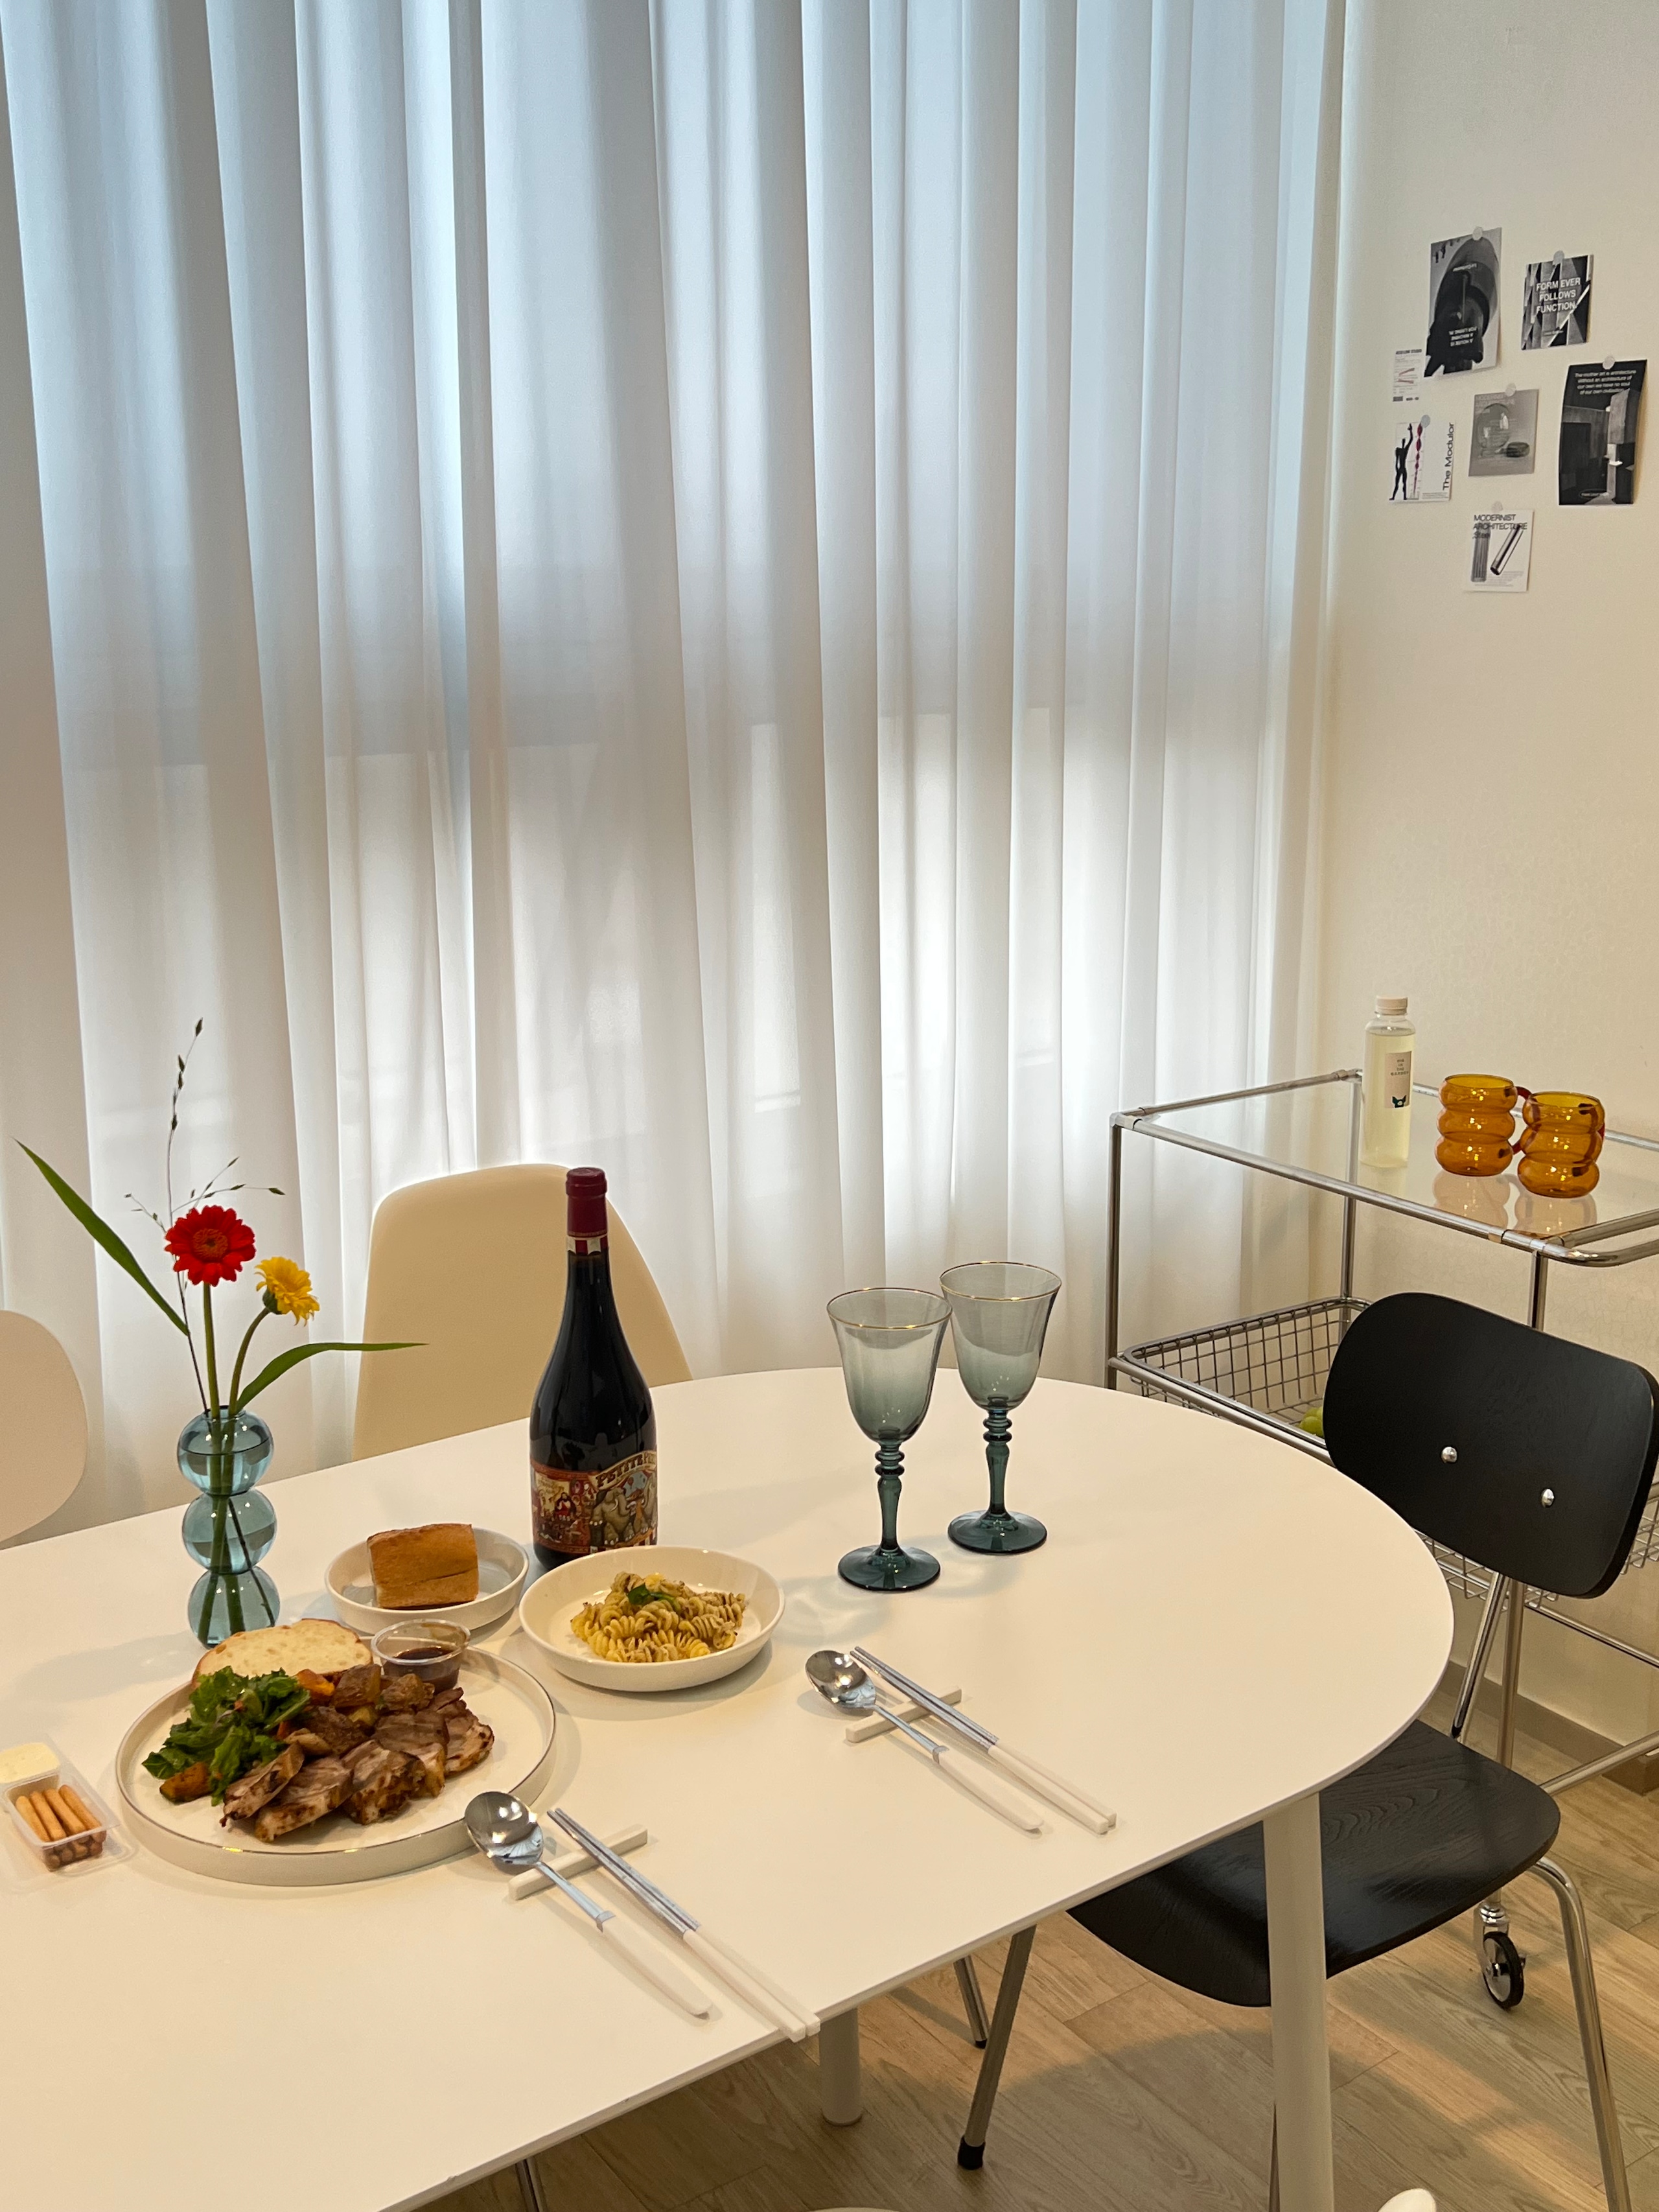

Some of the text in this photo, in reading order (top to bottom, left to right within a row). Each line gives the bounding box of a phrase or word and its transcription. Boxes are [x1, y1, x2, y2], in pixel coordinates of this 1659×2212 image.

[1536, 277, 1581, 292] FORM EVER
[1539, 290, 1576, 302] FOLLOWS
[1443, 423, 1454, 491] The Modulor
